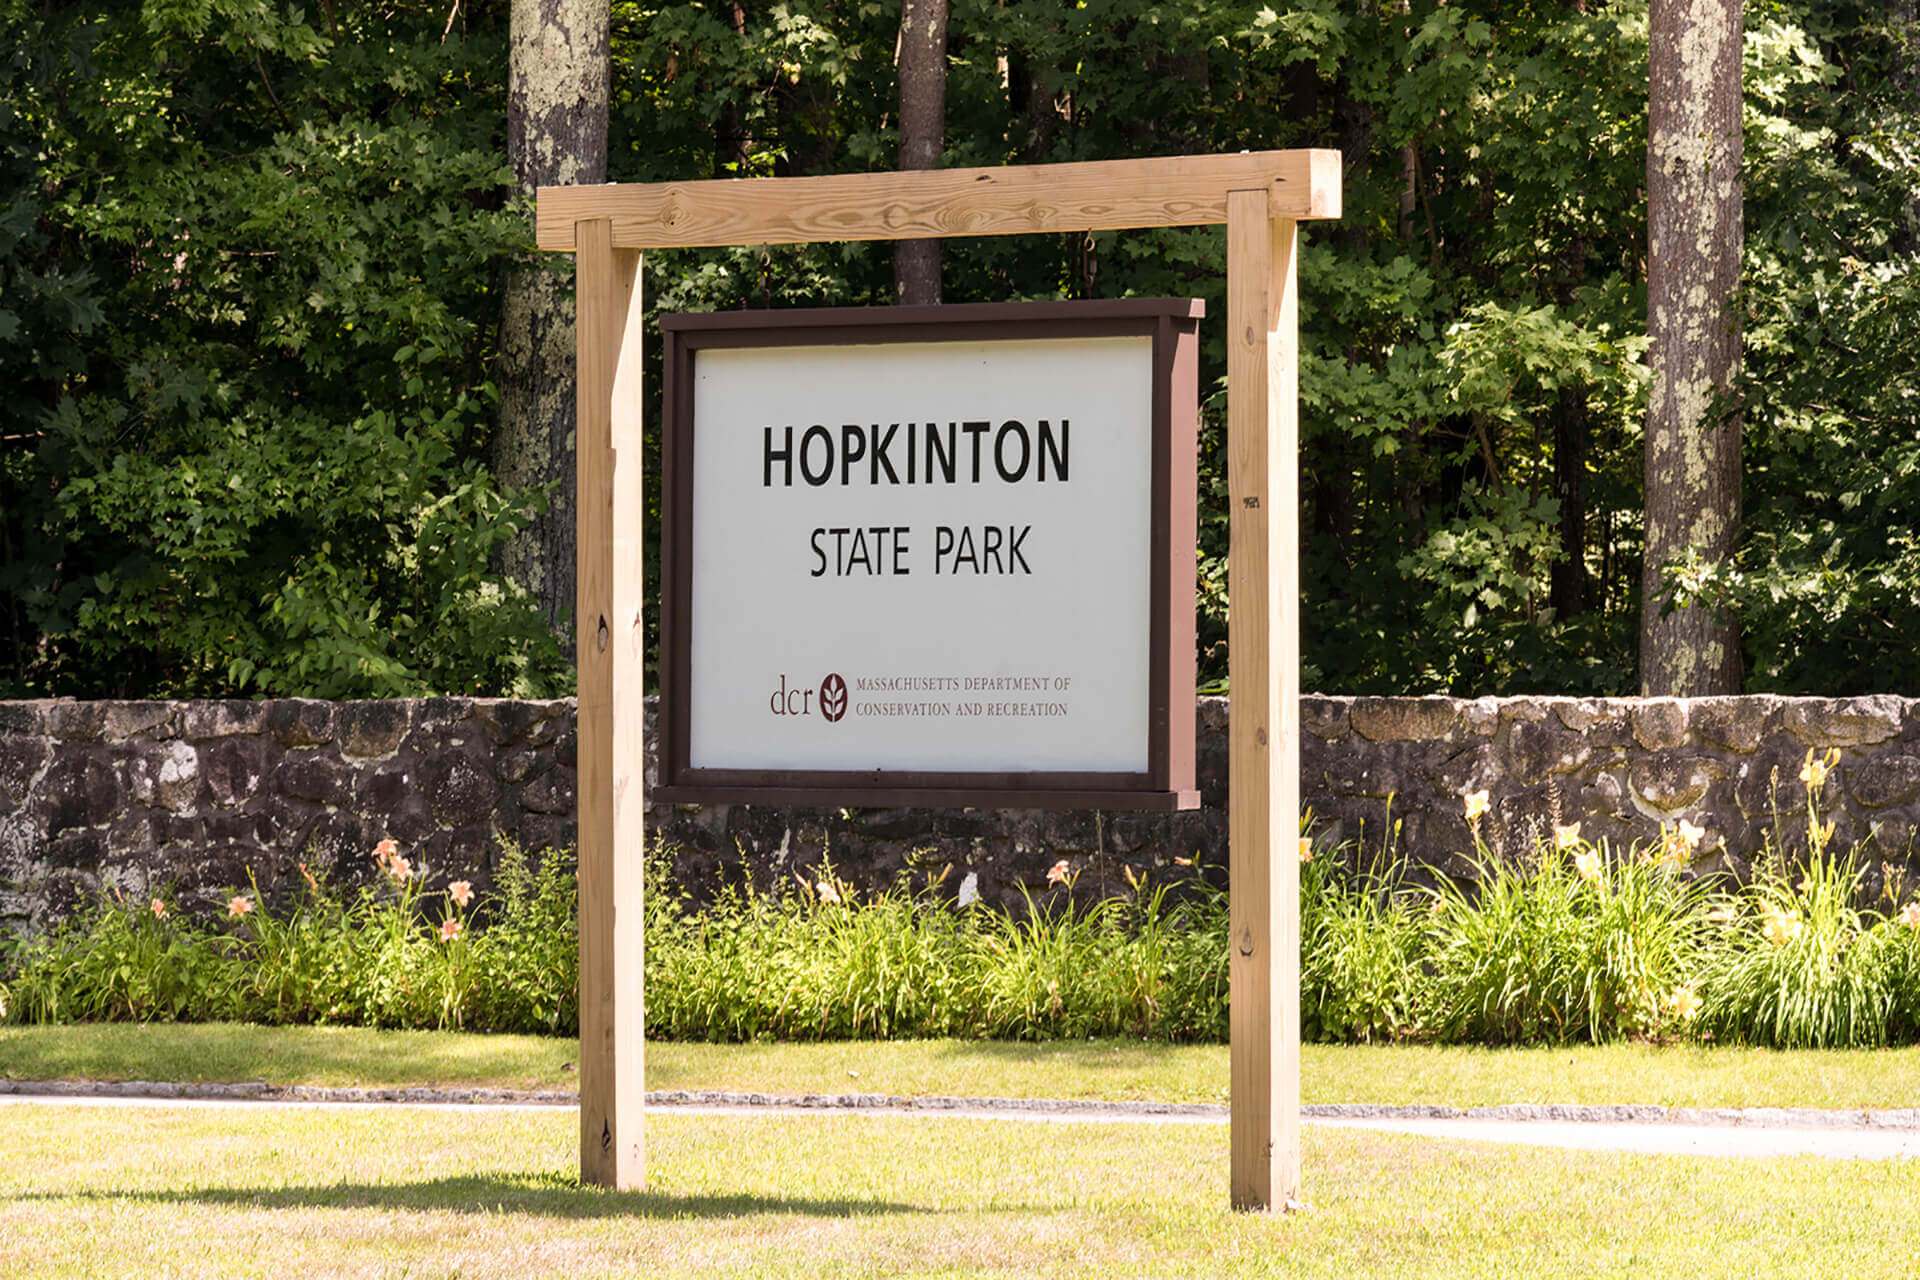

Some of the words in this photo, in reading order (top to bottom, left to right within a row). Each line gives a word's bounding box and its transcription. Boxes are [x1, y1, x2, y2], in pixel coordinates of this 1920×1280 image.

[763, 419, 1069, 487] HOPKINTON
[810, 526, 911, 577] STATE
[935, 526, 1033, 575] PARK
[770, 674, 814, 716] dcr
[855, 676, 960, 691] MASSACHUSETTS
[963, 676, 1050, 691] DEPARTMENT
[1053, 676, 1072, 691] OF
[855, 702, 951, 717] CONSERVATION
[955, 702, 983, 717] AND
[986, 702, 1068, 717] RECREATION
